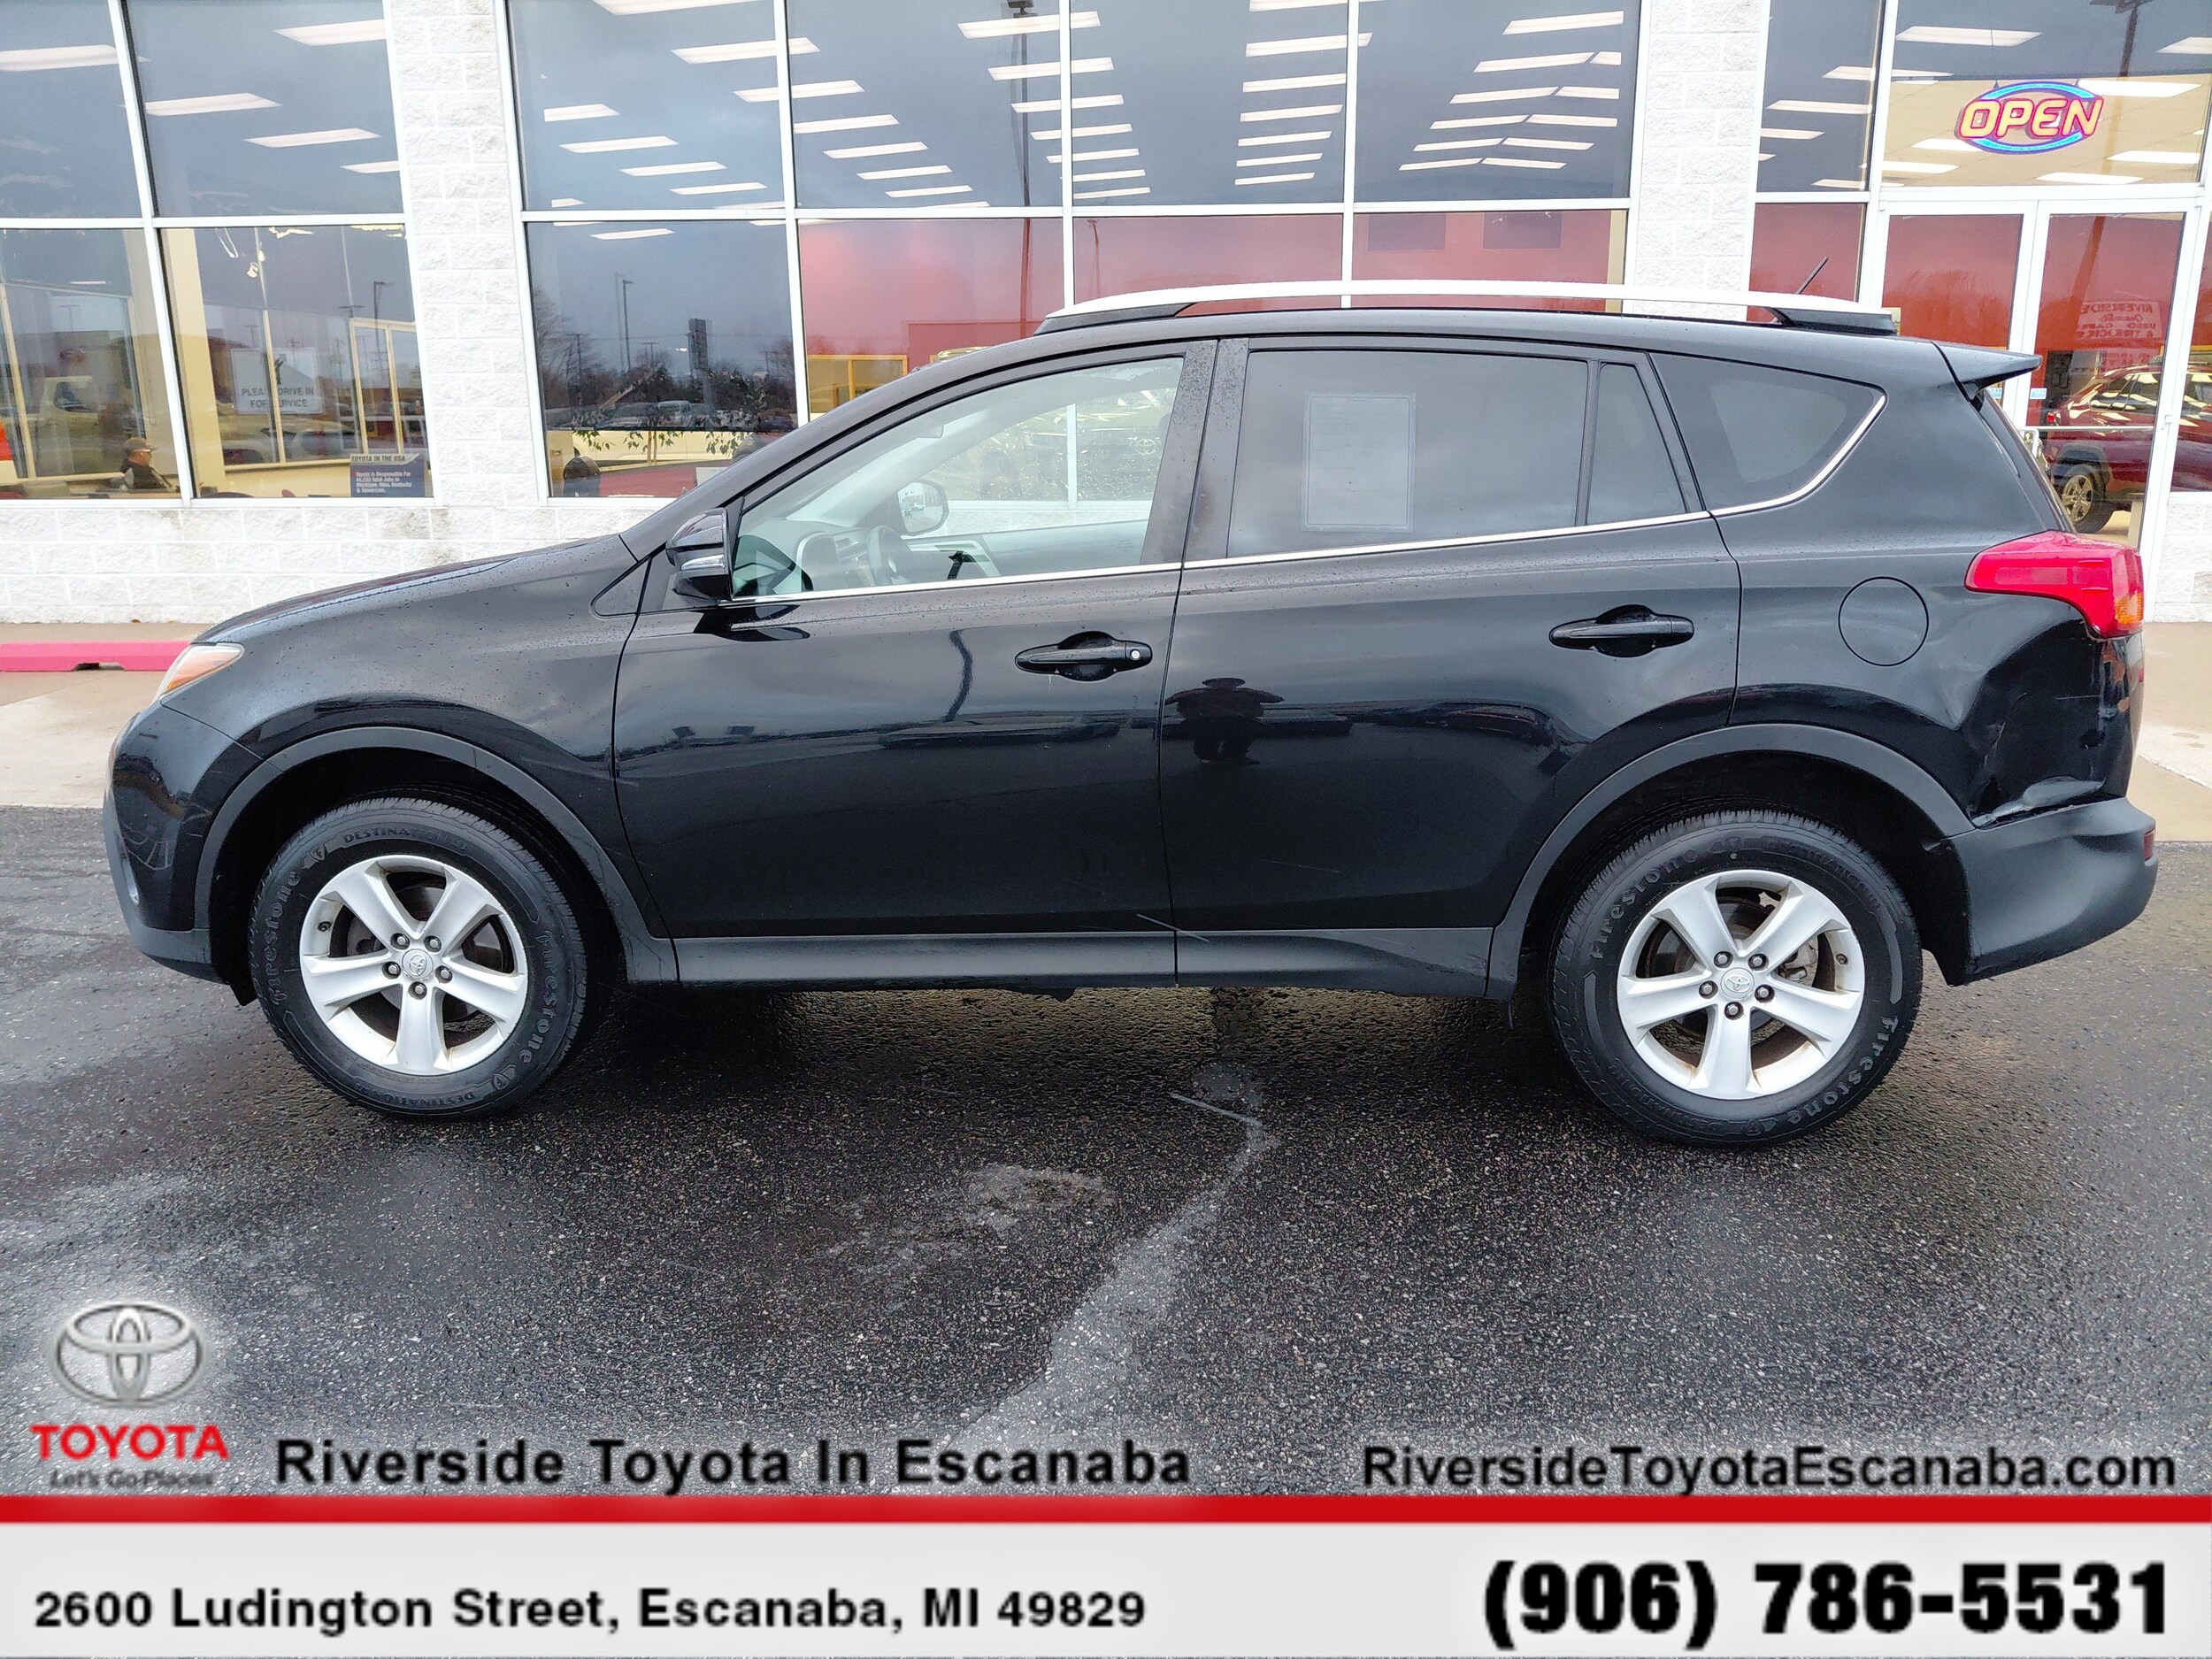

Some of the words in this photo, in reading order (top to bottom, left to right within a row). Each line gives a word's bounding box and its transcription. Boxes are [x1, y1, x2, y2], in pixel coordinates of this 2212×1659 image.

[1958, 96, 2104, 140] OPEN
[241, 387, 266, 396] PLEA
[278, 387, 303, 396] DRIVE
[304, 387, 314, 396] IN
[265, 871, 301, 1006] Firestone
[1591, 849, 1698, 960] Firestone
[518, 929, 561, 1064] Firestone
[1787, 1015, 1900, 1126] Firestone
